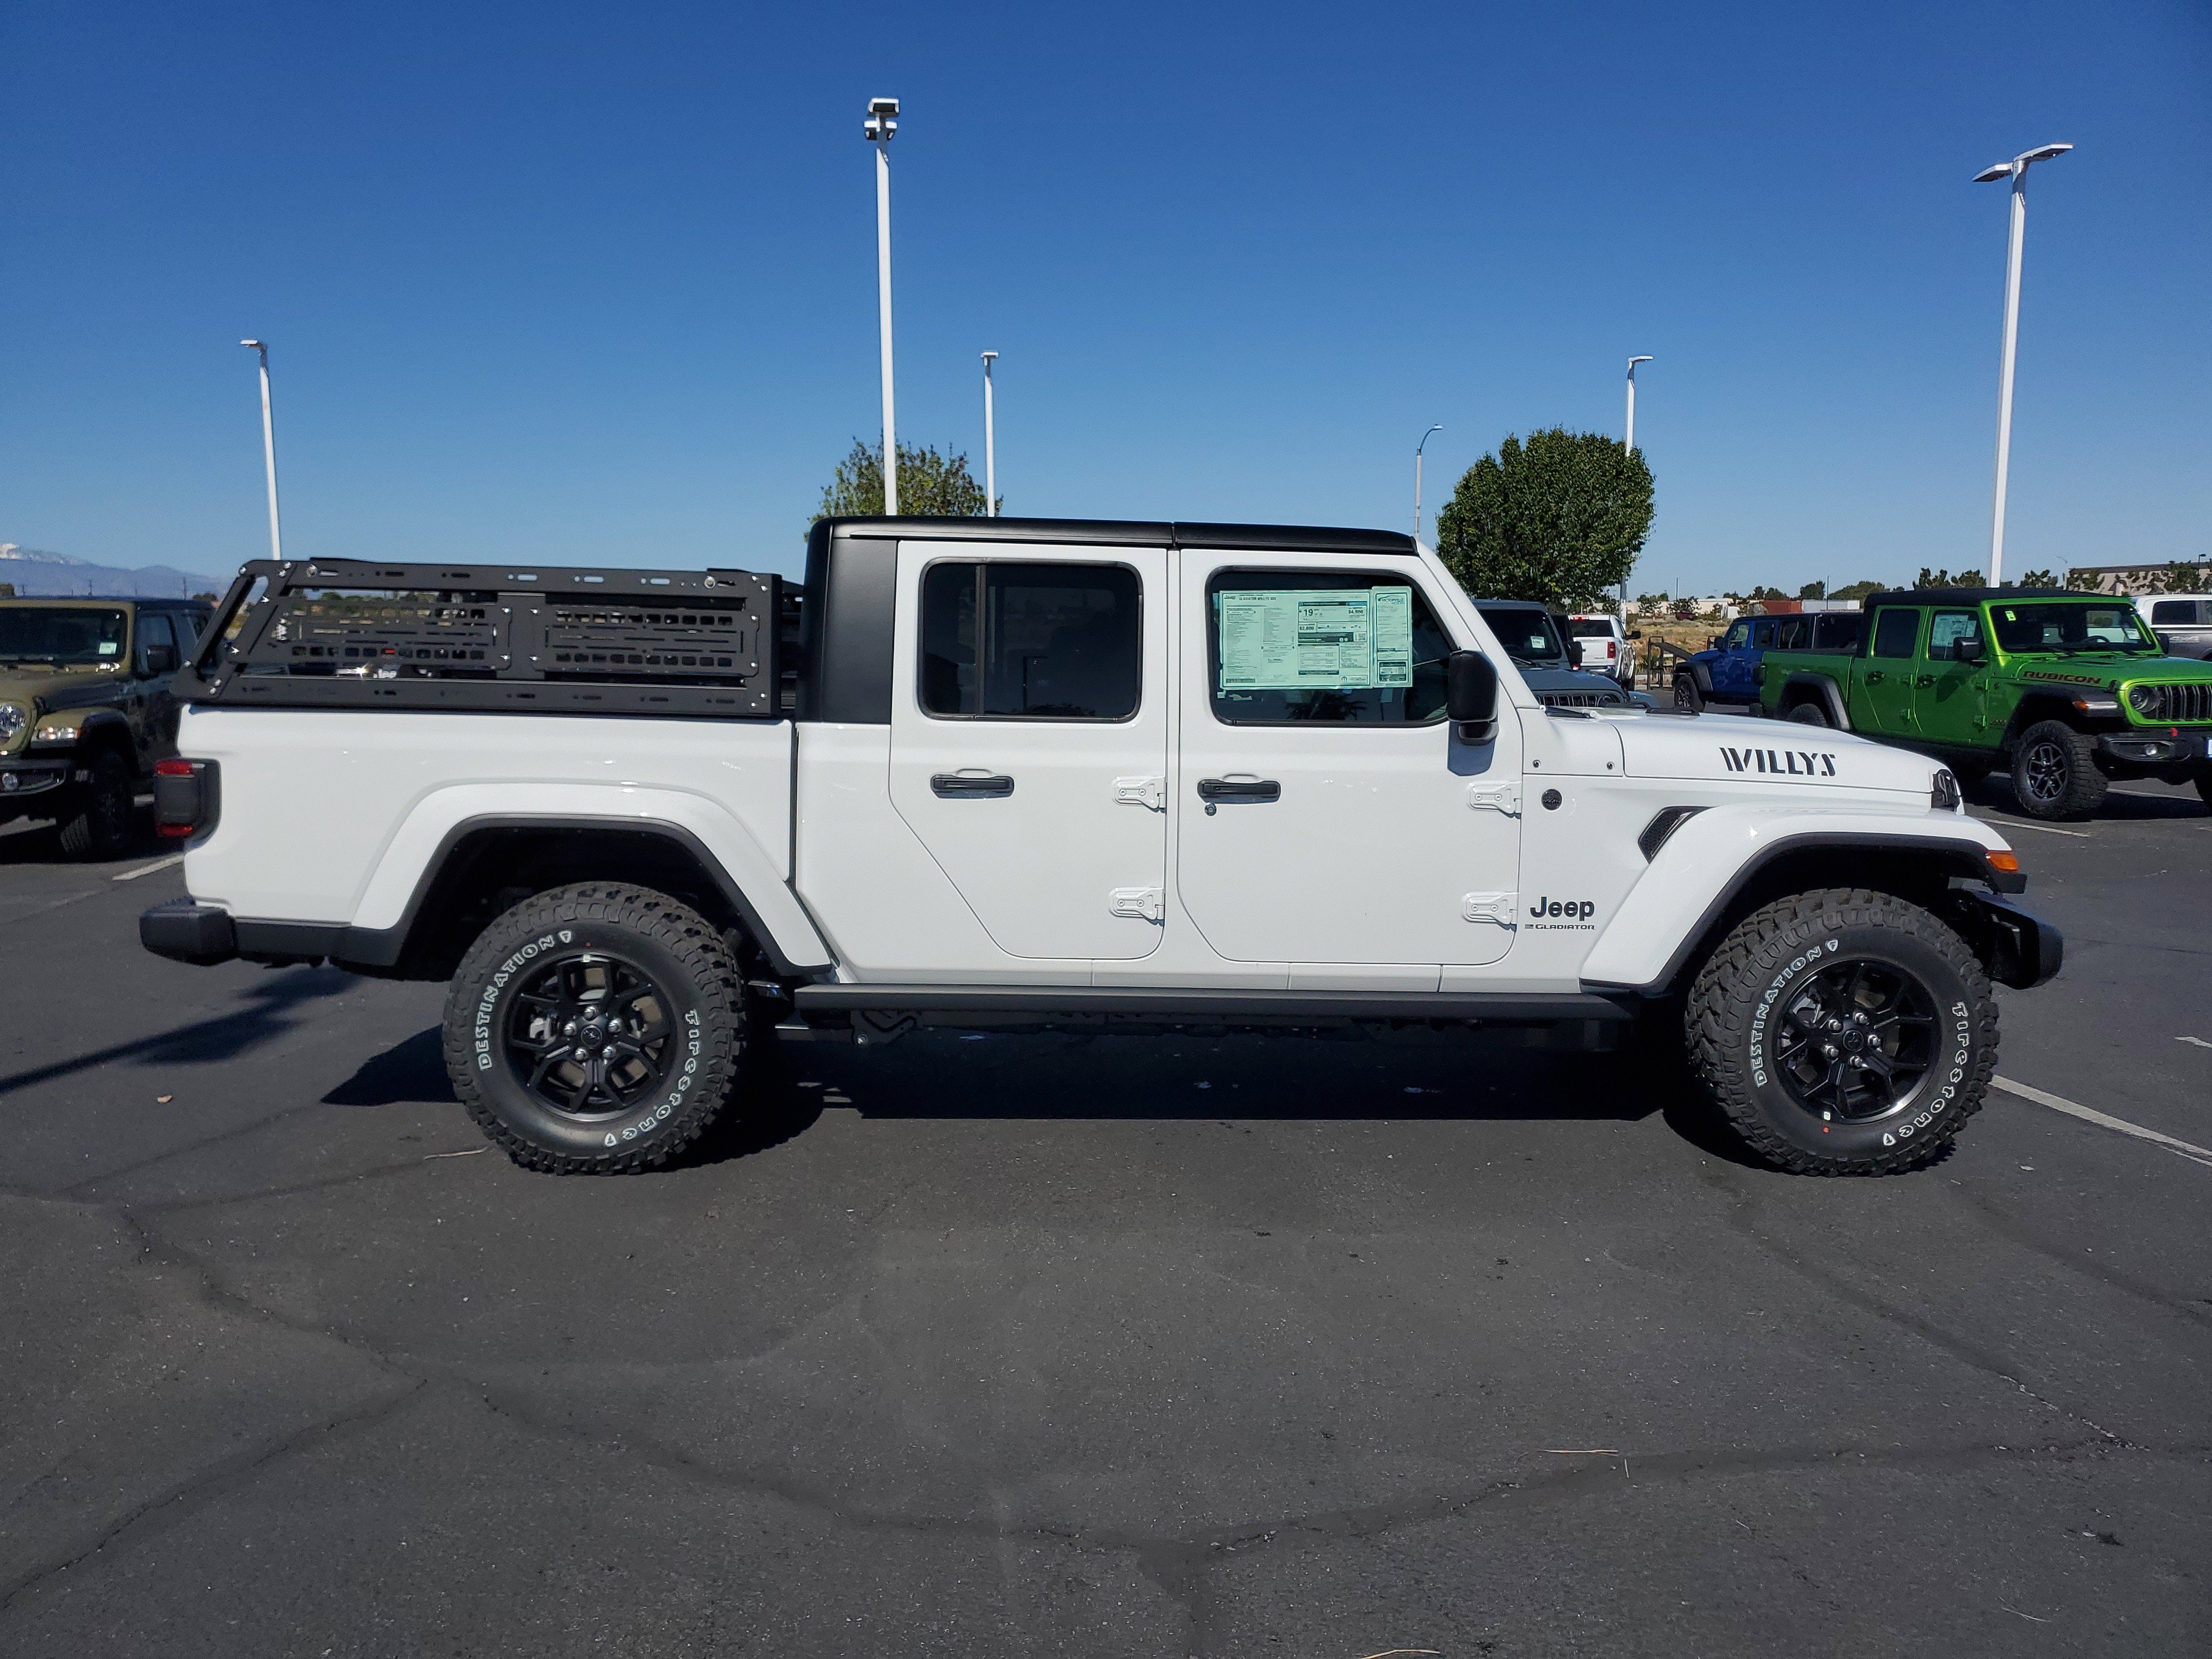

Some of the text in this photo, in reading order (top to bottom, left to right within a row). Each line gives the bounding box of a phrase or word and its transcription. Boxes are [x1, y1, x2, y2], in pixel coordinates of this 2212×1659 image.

[2023, 670, 2102, 684] RUBICON
[1719, 747, 1836, 777] WILLYS
[1530, 896, 1595, 922] Jeep
[473, 935, 556, 1070] DESTINATION
[1749, 945, 1822, 1088] DESTINATION
